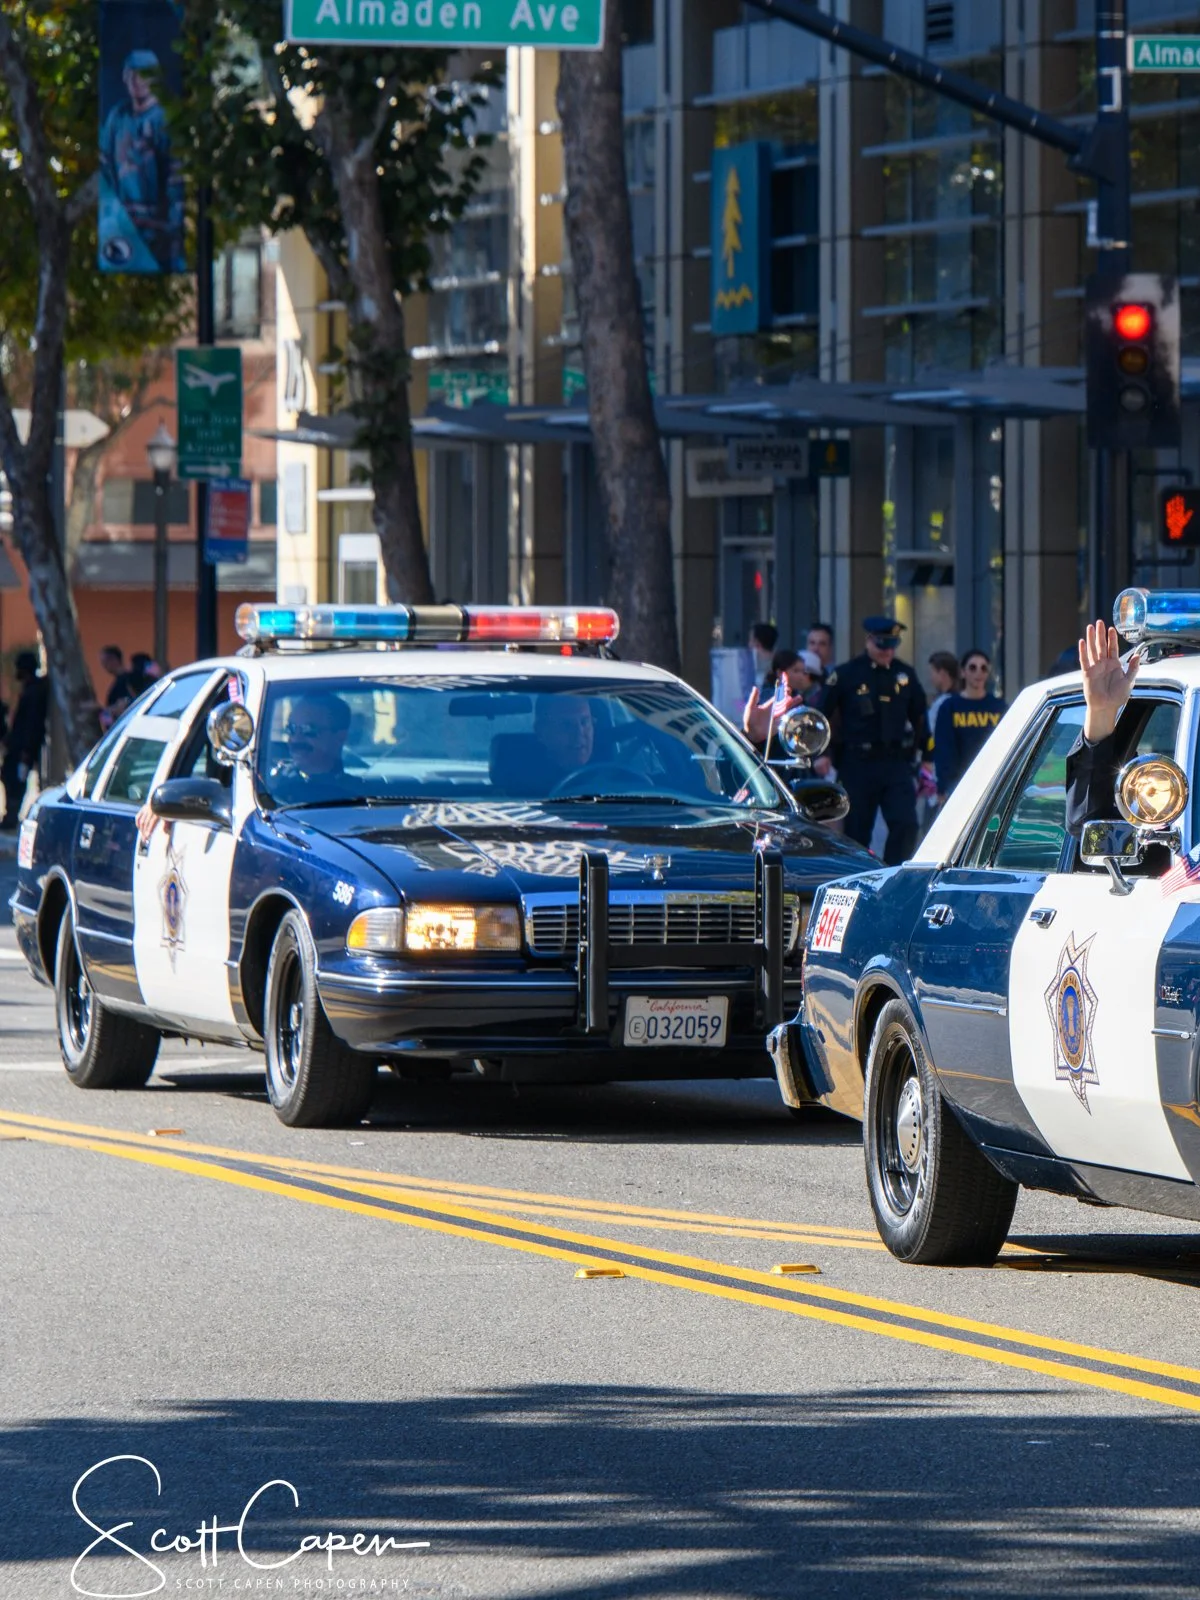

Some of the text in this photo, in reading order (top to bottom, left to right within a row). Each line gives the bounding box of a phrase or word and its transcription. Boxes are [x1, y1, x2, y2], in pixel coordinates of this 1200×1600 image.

[315, 0, 580, 31] Almaden Ave
[953, 711, 1000, 728] NAVY
[332, 880, 355, 906] 586
[649, 1000, 708, 1015] California
[646, 1015, 722, 1040] 032059
